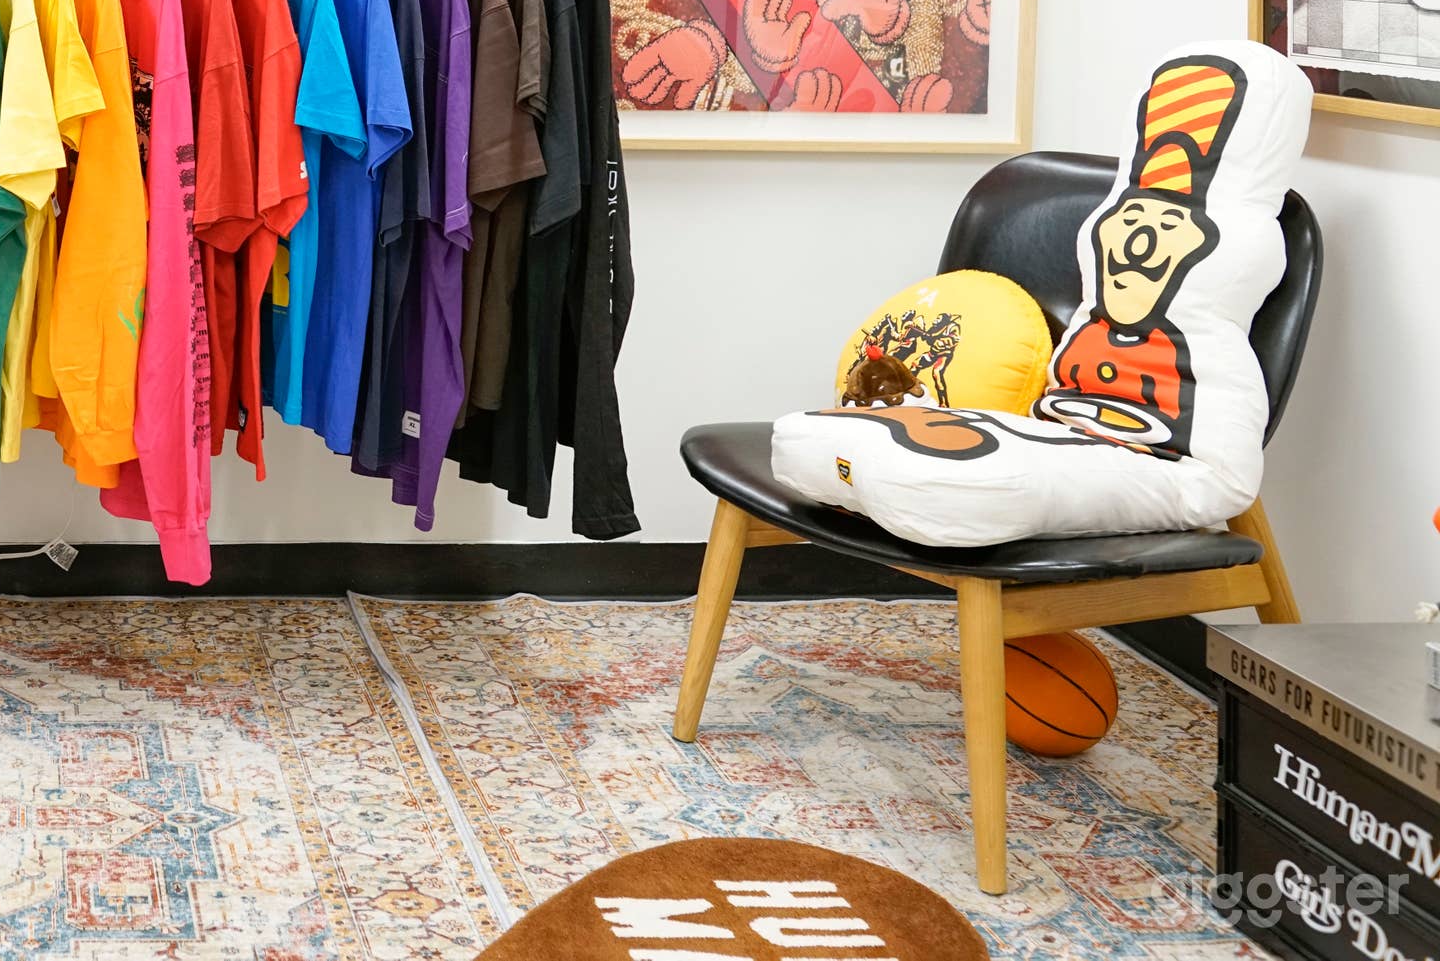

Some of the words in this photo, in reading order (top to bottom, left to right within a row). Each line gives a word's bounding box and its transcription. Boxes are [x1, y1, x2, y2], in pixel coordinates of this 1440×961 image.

[1230, 649, 1277, 695] GEARS
[1284, 680, 1314, 718] FOR
[1322, 701, 1427, 781] FUTURISTIC
[1274, 859, 1343, 934] Girls
